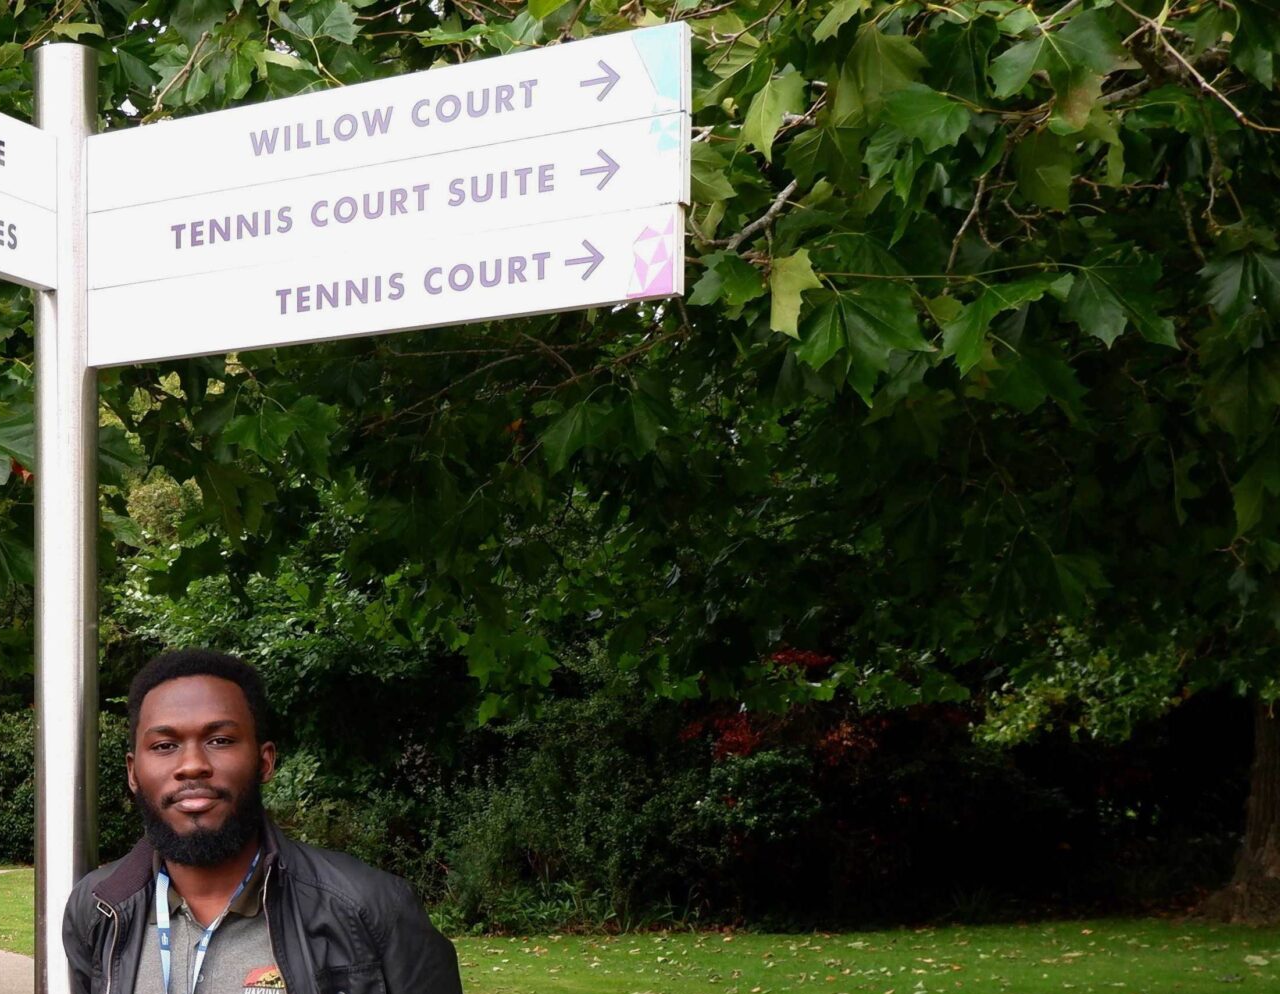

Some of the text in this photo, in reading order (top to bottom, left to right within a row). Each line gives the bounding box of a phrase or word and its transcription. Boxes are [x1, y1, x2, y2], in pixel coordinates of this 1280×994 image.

[250, 79, 538, 156] WILLOW COURT
[171, 164, 554, 249] TENNIS COURT SUITE
[276, 252, 550, 315] TENNIS COURT
